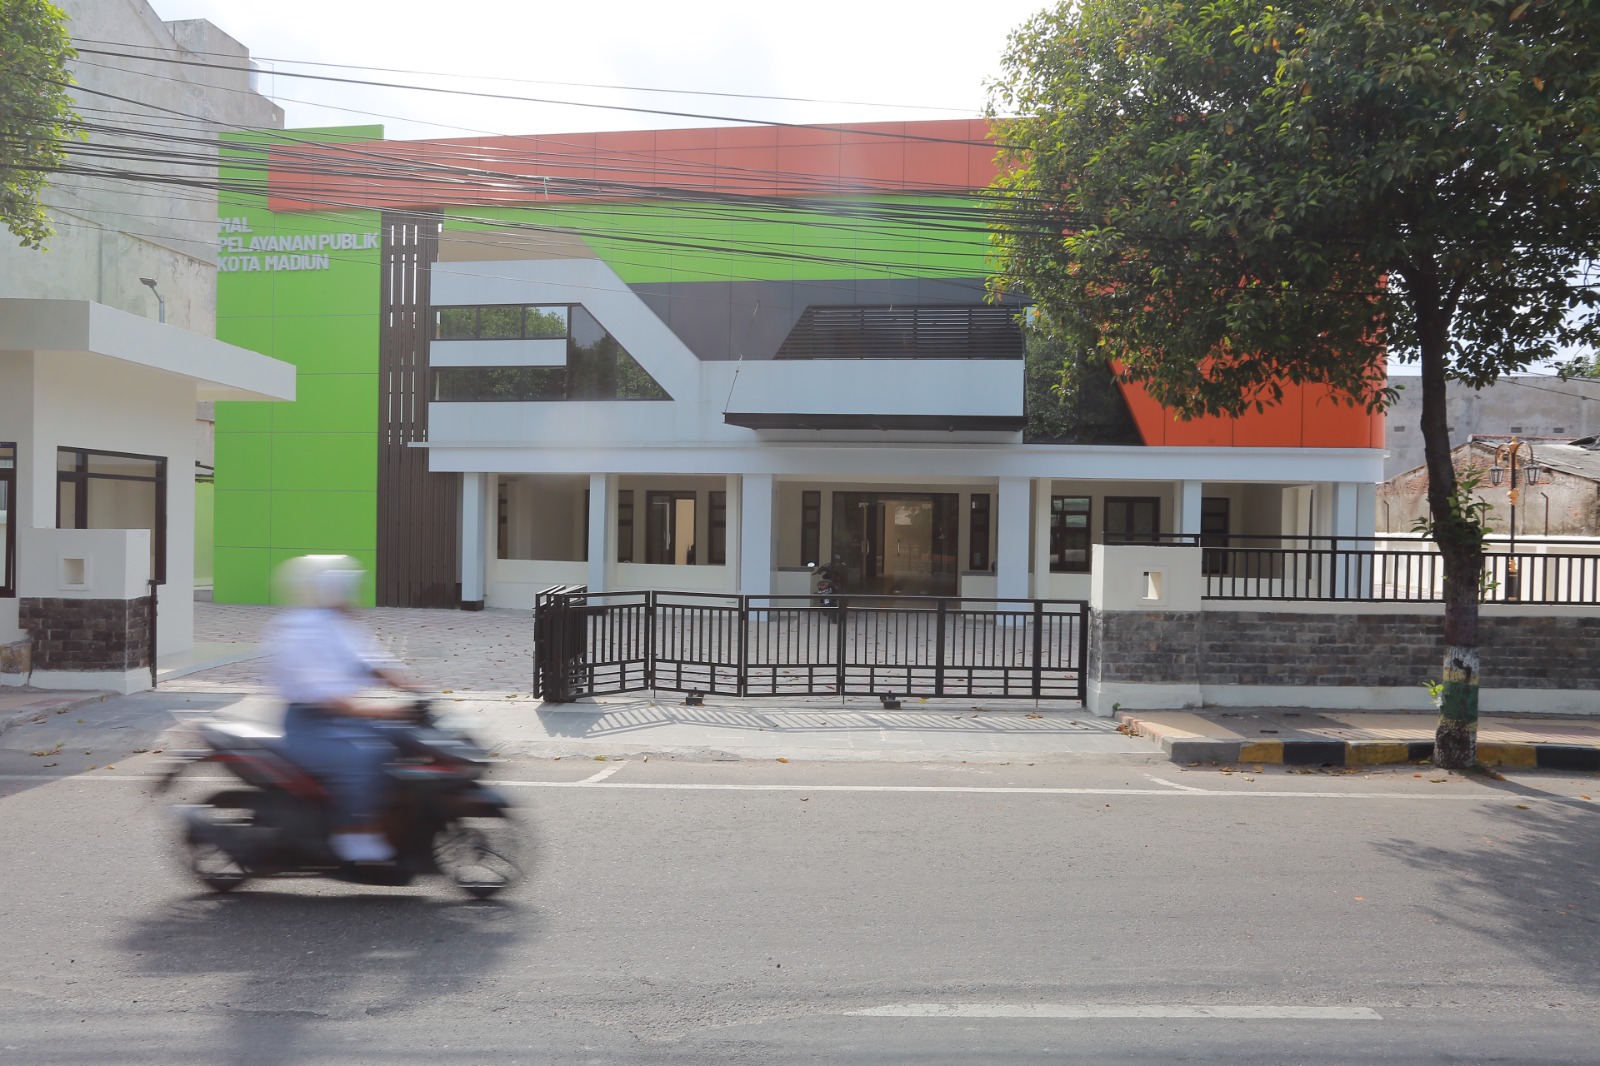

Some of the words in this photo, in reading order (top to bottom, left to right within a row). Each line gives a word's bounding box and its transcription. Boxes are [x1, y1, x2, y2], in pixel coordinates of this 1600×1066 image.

[217, 217, 253, 233] MAL
[217, 235, 317, 252] PELAYANAN
[319, 232, 379, 250] PUBLIK
[217, 256, 262, 272] KOTA
[265, 254, 329, 271] MADIUN
